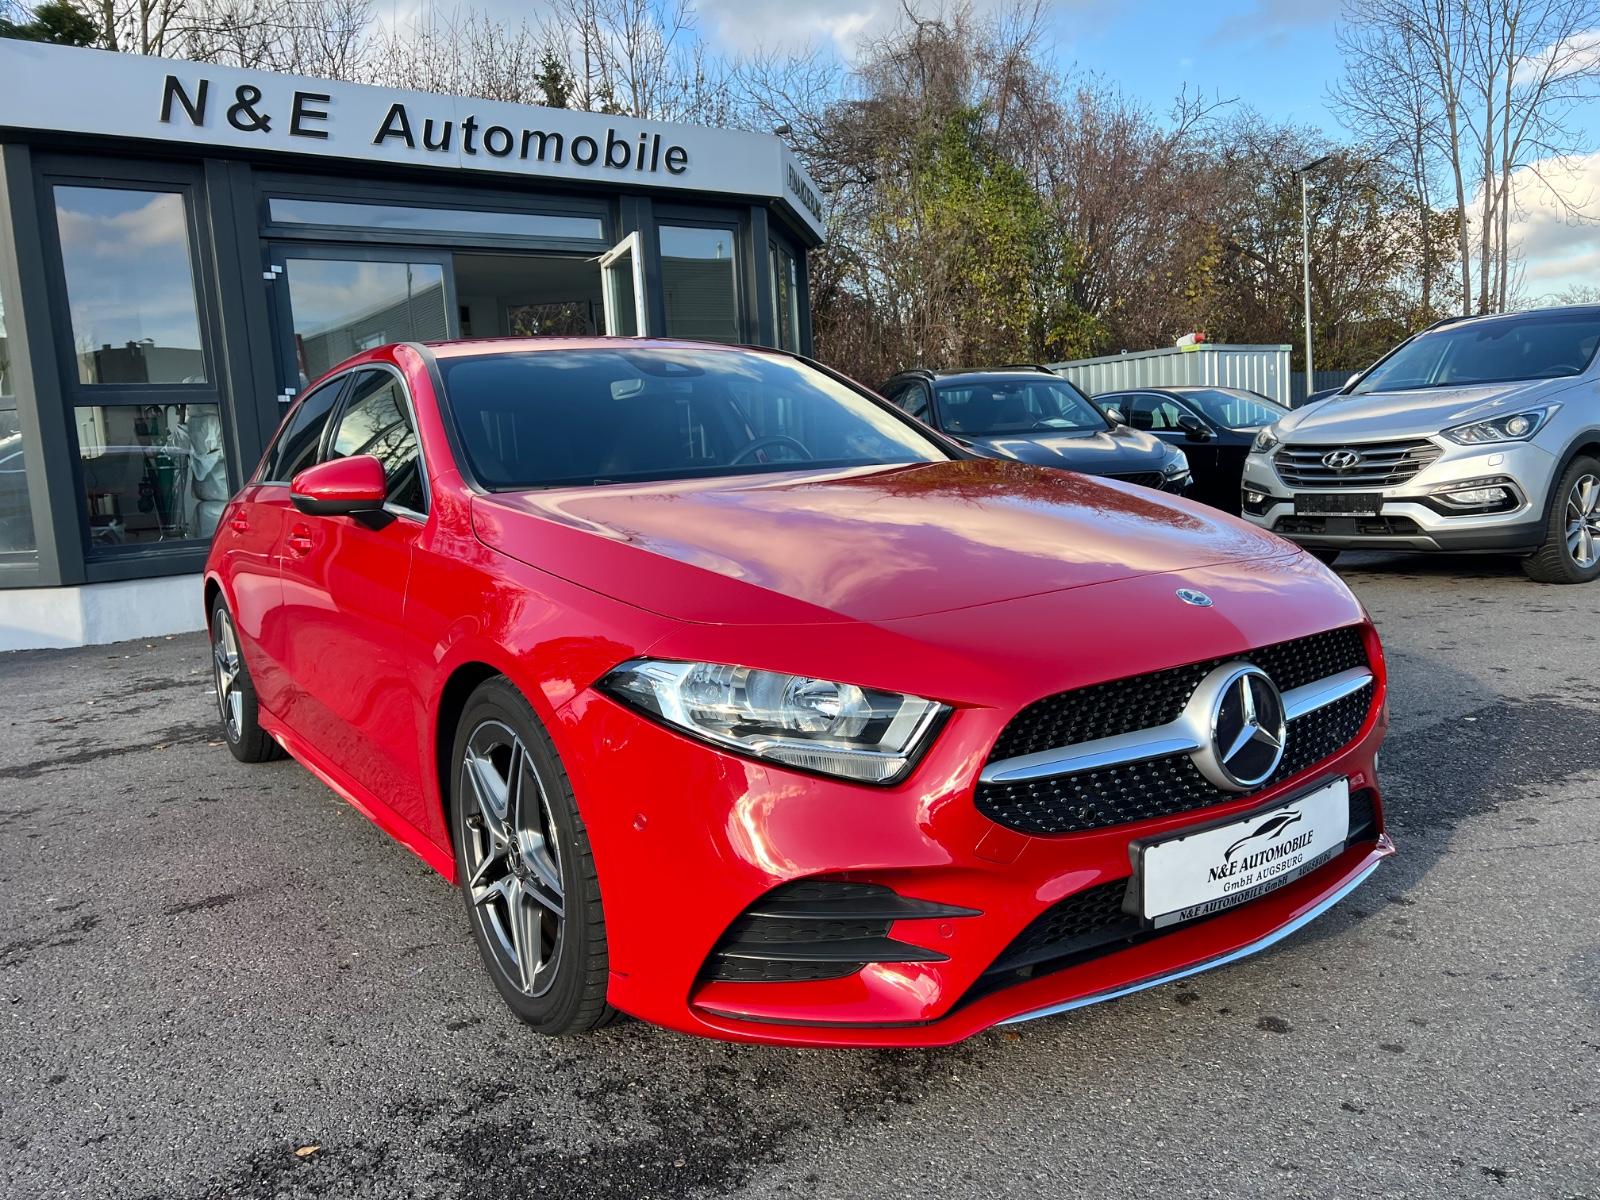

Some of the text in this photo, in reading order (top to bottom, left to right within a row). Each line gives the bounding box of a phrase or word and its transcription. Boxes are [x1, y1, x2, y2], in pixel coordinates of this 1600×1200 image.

[370, 102, 690, 175] Automobile
[1179, 850, 1332, 921] N&E AUTOMOBILE GmbH AUGSBURG
[1207, 829, 1314, 883] N&E AUTOMOBILE
[1223, 853, 1303, 892] GmbH AUGSBURG
